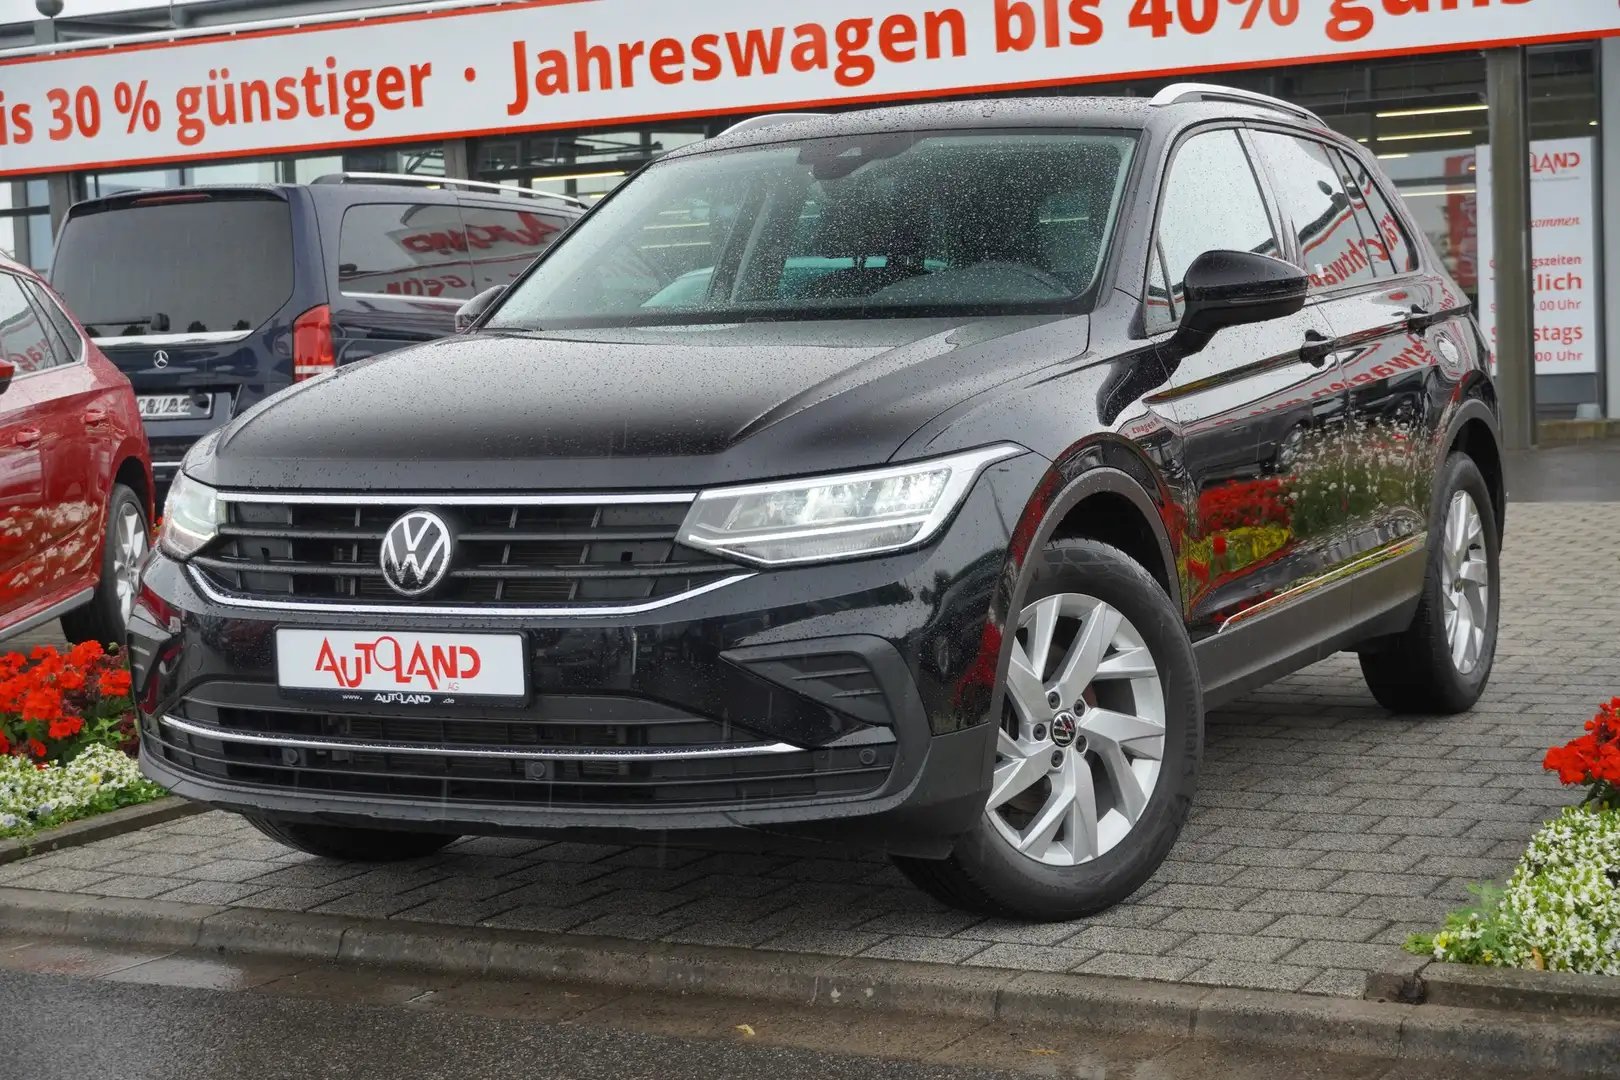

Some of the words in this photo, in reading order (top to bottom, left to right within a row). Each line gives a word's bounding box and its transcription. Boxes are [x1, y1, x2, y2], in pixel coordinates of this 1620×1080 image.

[48, 85, 101, 141] 30
[114, 80, 161, 134] %
[176, 56, 432, 146] günstiger
[507, 5, 967, 116] Jahreswagen
[1529, 151, 1581, 174] LAND
[1532, 272, 1583, 292] lich
[1557, 299, 1582, 311] Uhr
[1556, 351, 1583, 362] Uhr
[315, 636, 481, 690] AUTOLAND
